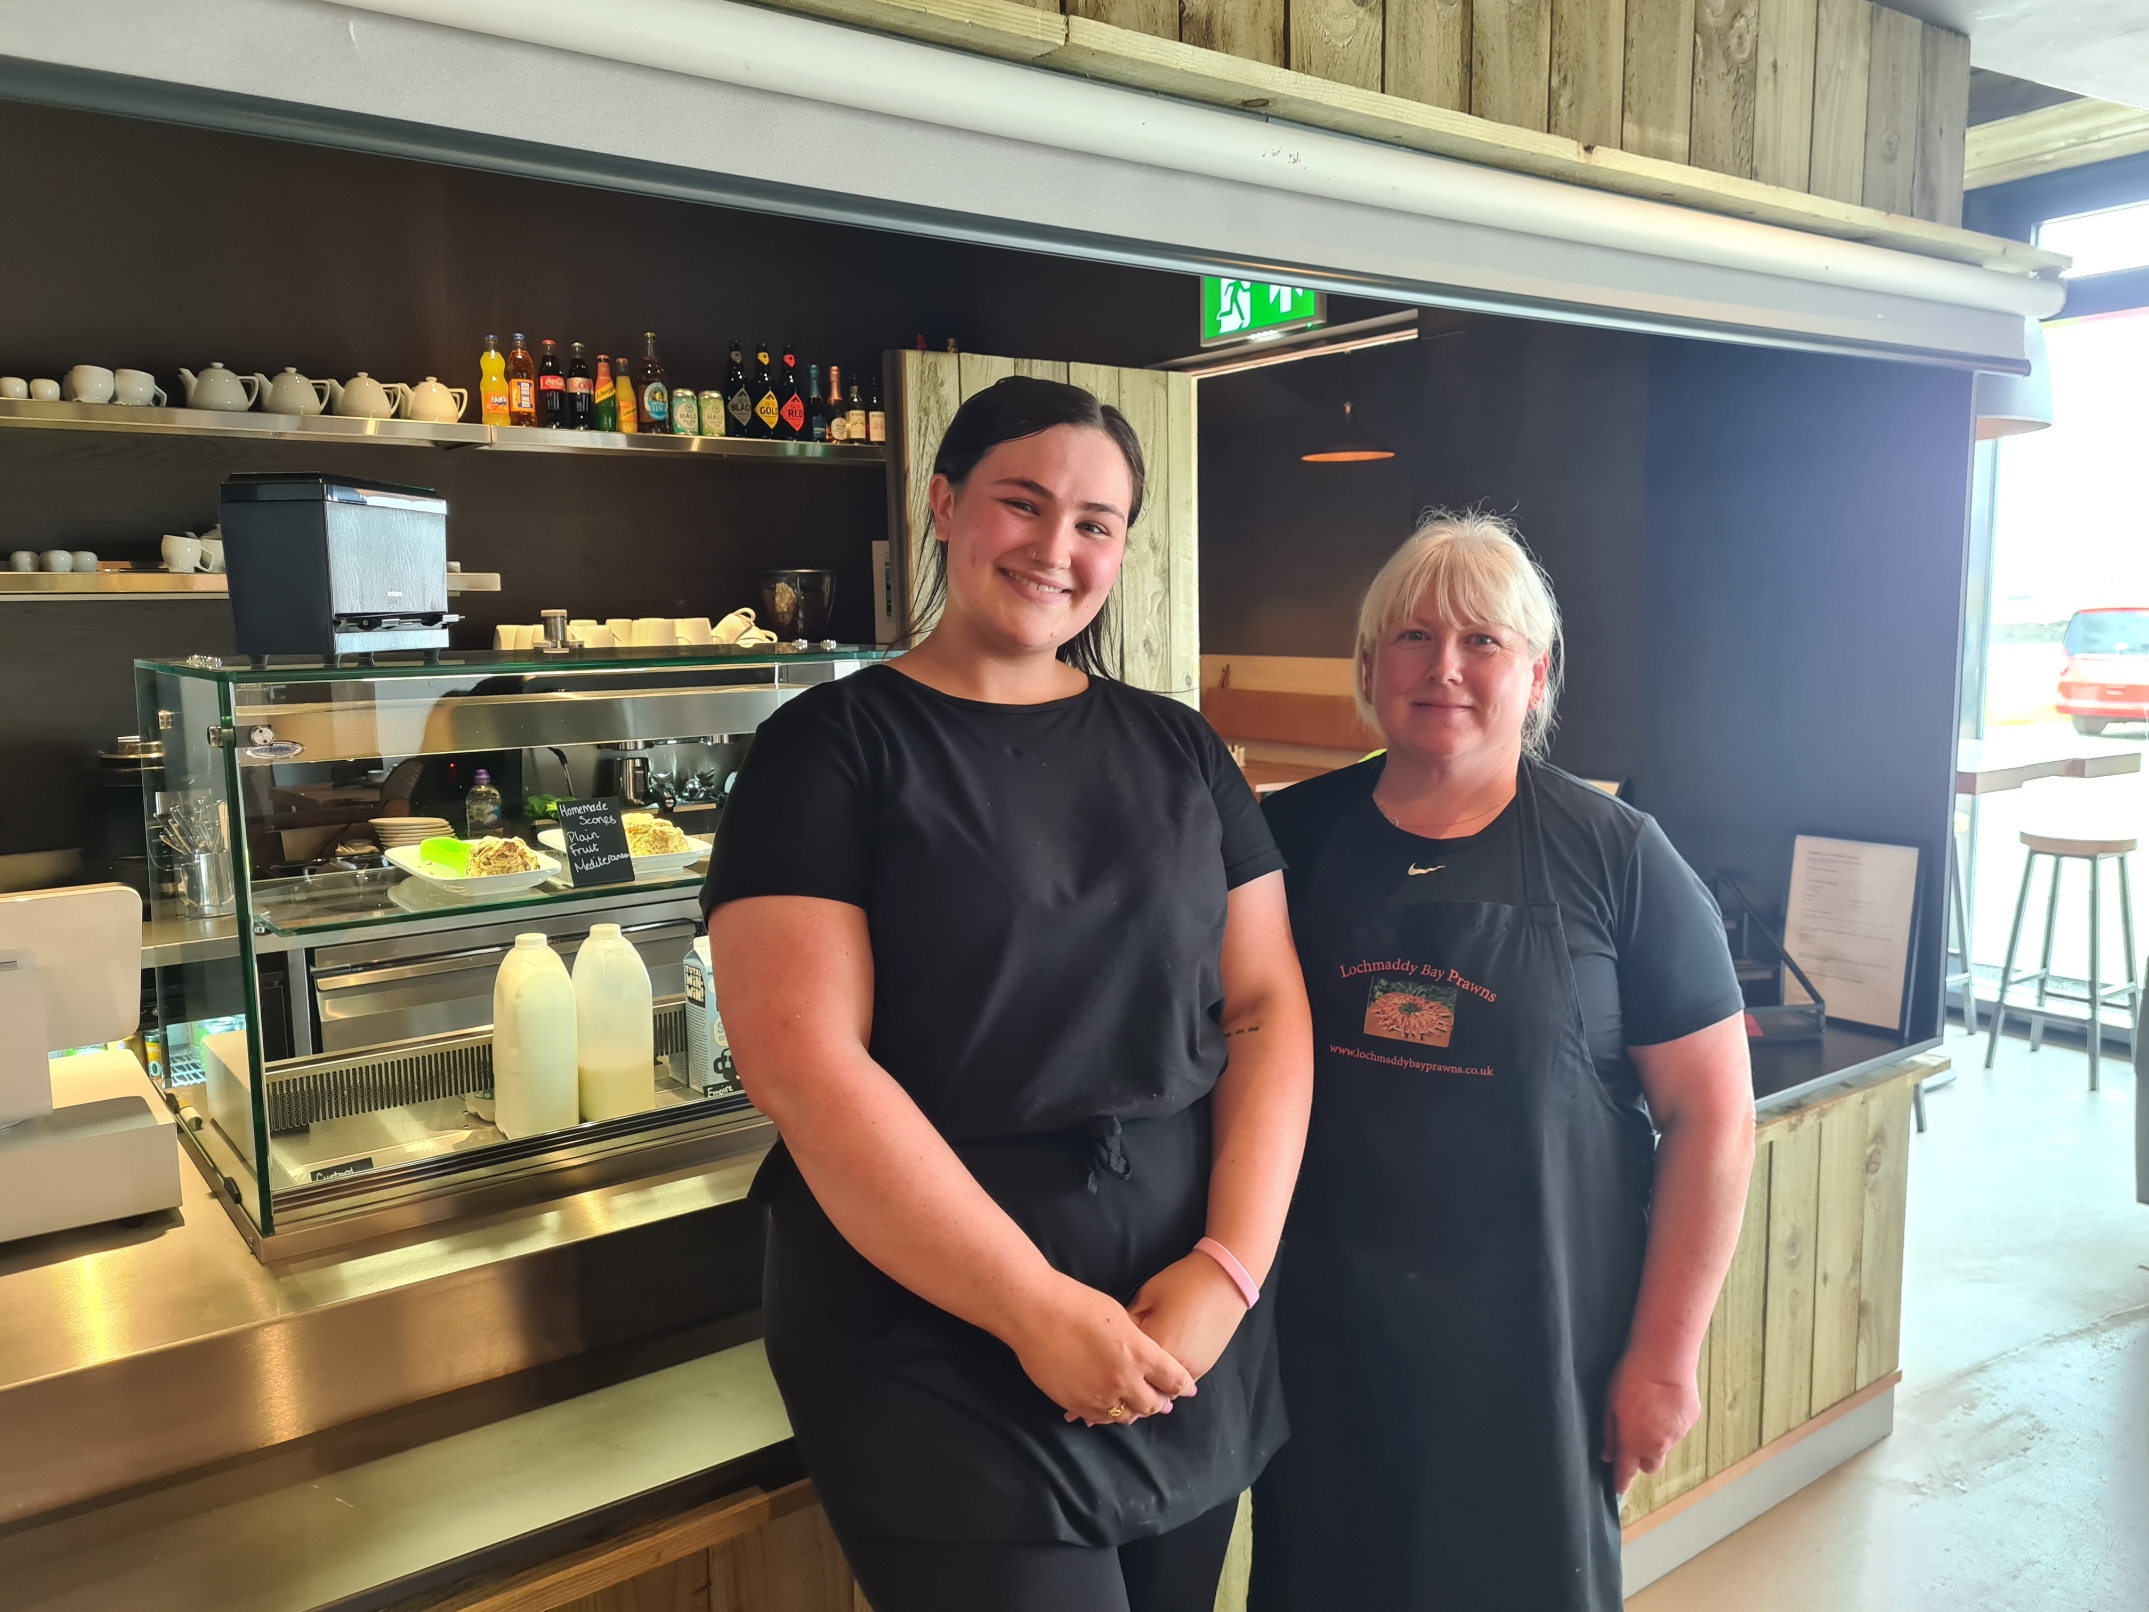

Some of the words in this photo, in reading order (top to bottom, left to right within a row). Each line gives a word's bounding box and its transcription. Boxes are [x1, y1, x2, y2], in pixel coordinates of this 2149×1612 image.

[731, 403, 751, 412] BLAC
[559, 801, 608, 817] Homemade
[579, 815, 617, 826] Scones
[567, 828, 600, 843] Plain
[569, 842, 600, 857] Fruit
[1339, 958, 1418, 978] Lochmaddy
[1420, 964, 1446, 982] Bay
[1446, 968, 1497, 1003] Prawns
[1330, 1044, 1494, 1077] www.lochmaddybayprawns.co.uk
